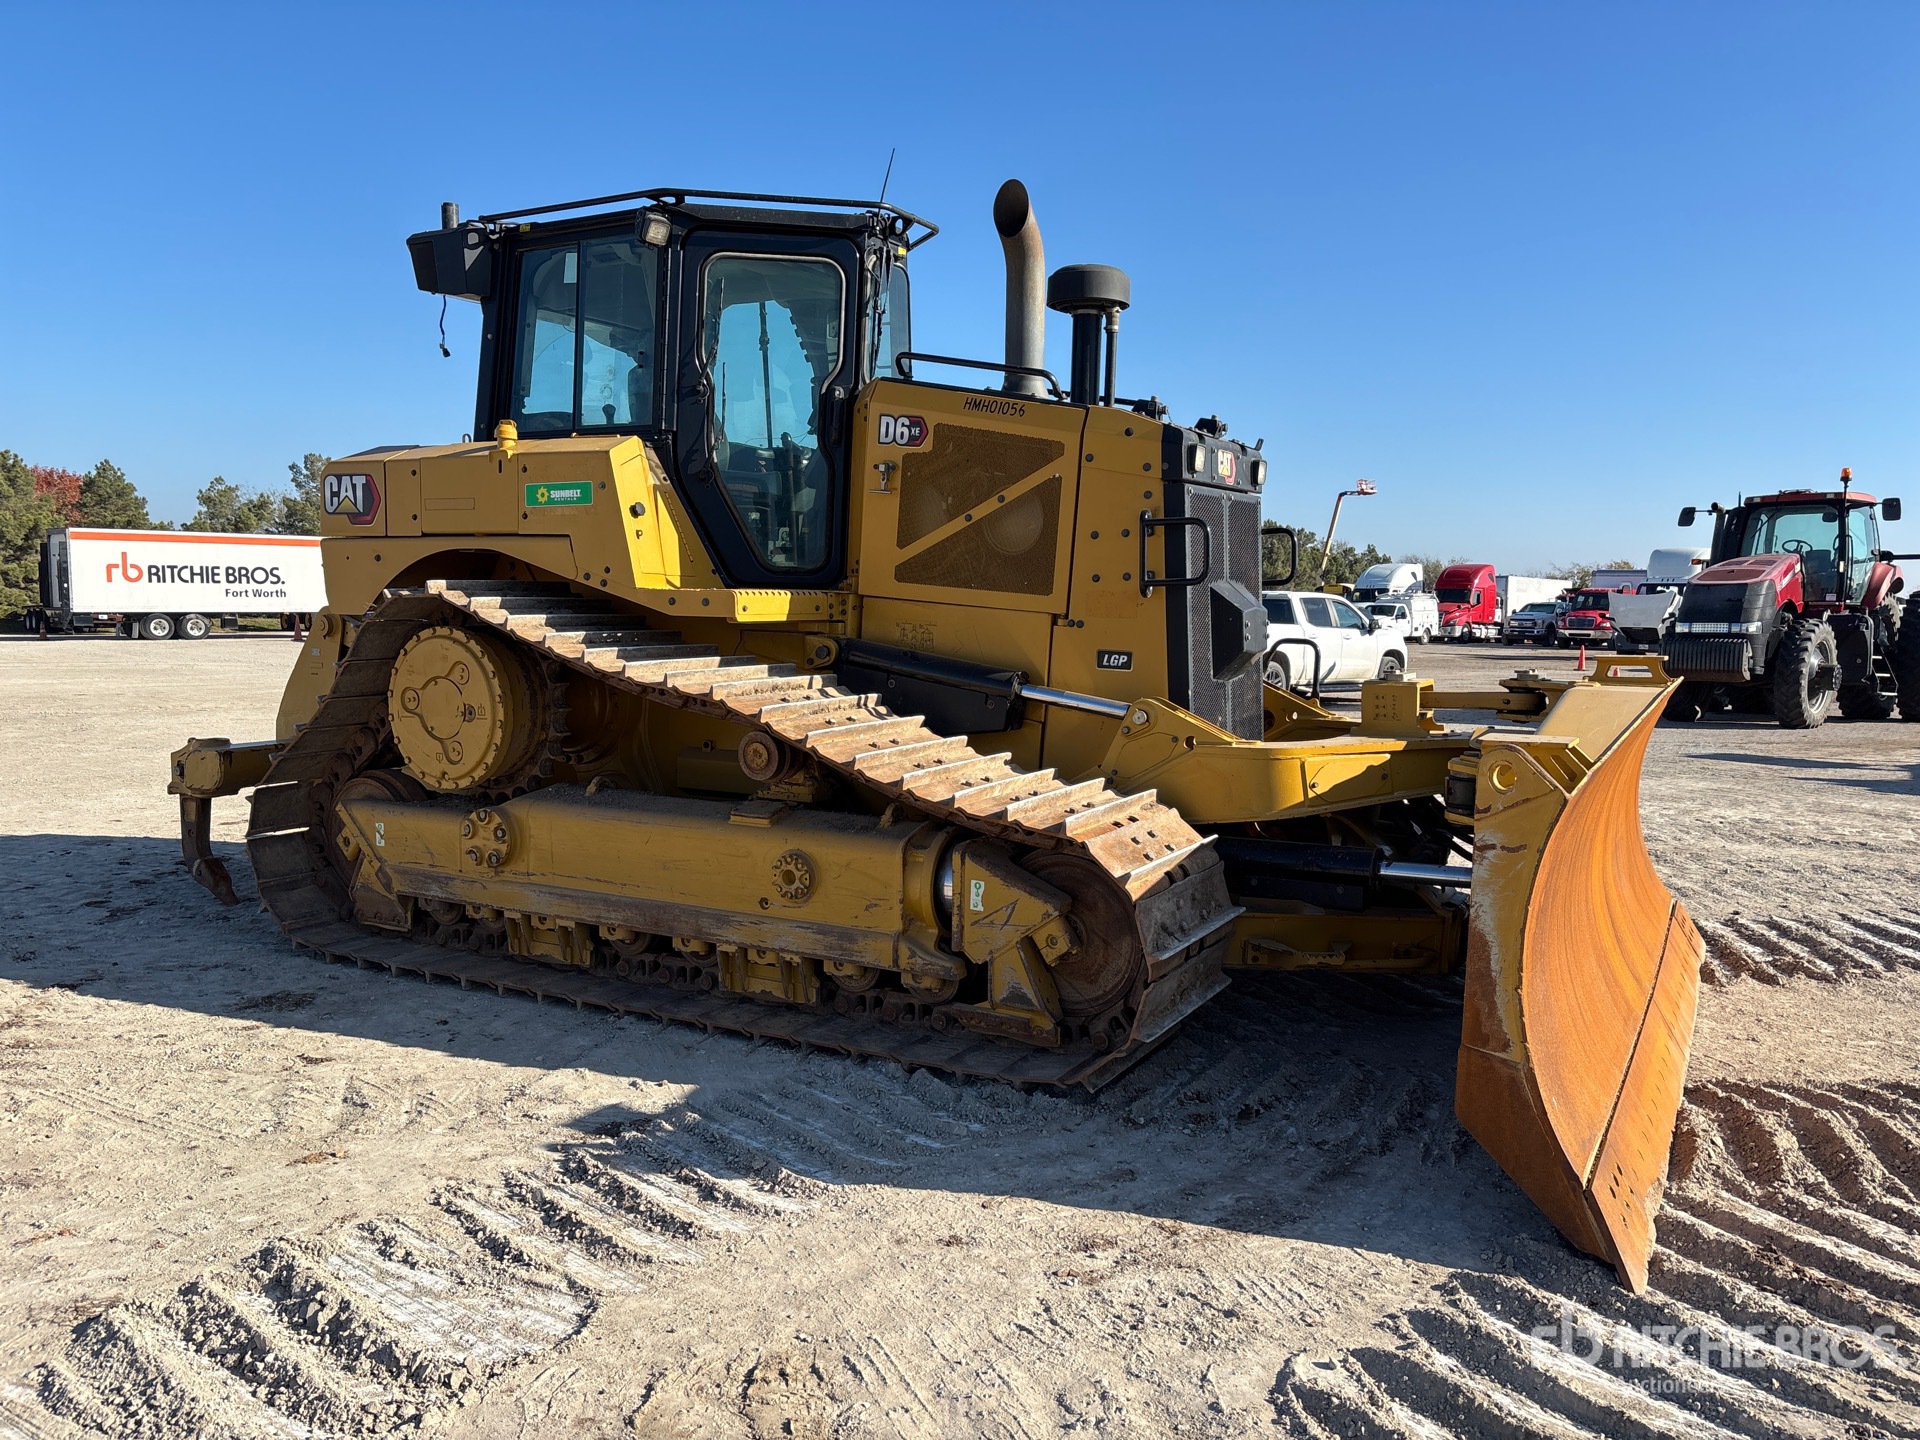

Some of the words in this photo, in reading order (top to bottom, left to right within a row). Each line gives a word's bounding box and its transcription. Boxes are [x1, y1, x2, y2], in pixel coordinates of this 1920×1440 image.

[963, 396, 1026, 417] HMH01056
[879, 415, 910, 445] D6
[910, 427, 921, 437] XE
[324, 475, 367, 513] CAT
[550, 489, 582, 498] SUNBELT
[106, 551, 144, 583] rb
[147, 565, 221, 584] RITCHIE
[225, 566, 286, 585] BROS.
[225, 588, 249, 598] Fort
[252, 588, 286, 598] Worth
[1102, 653, 1128, 667] LGP
